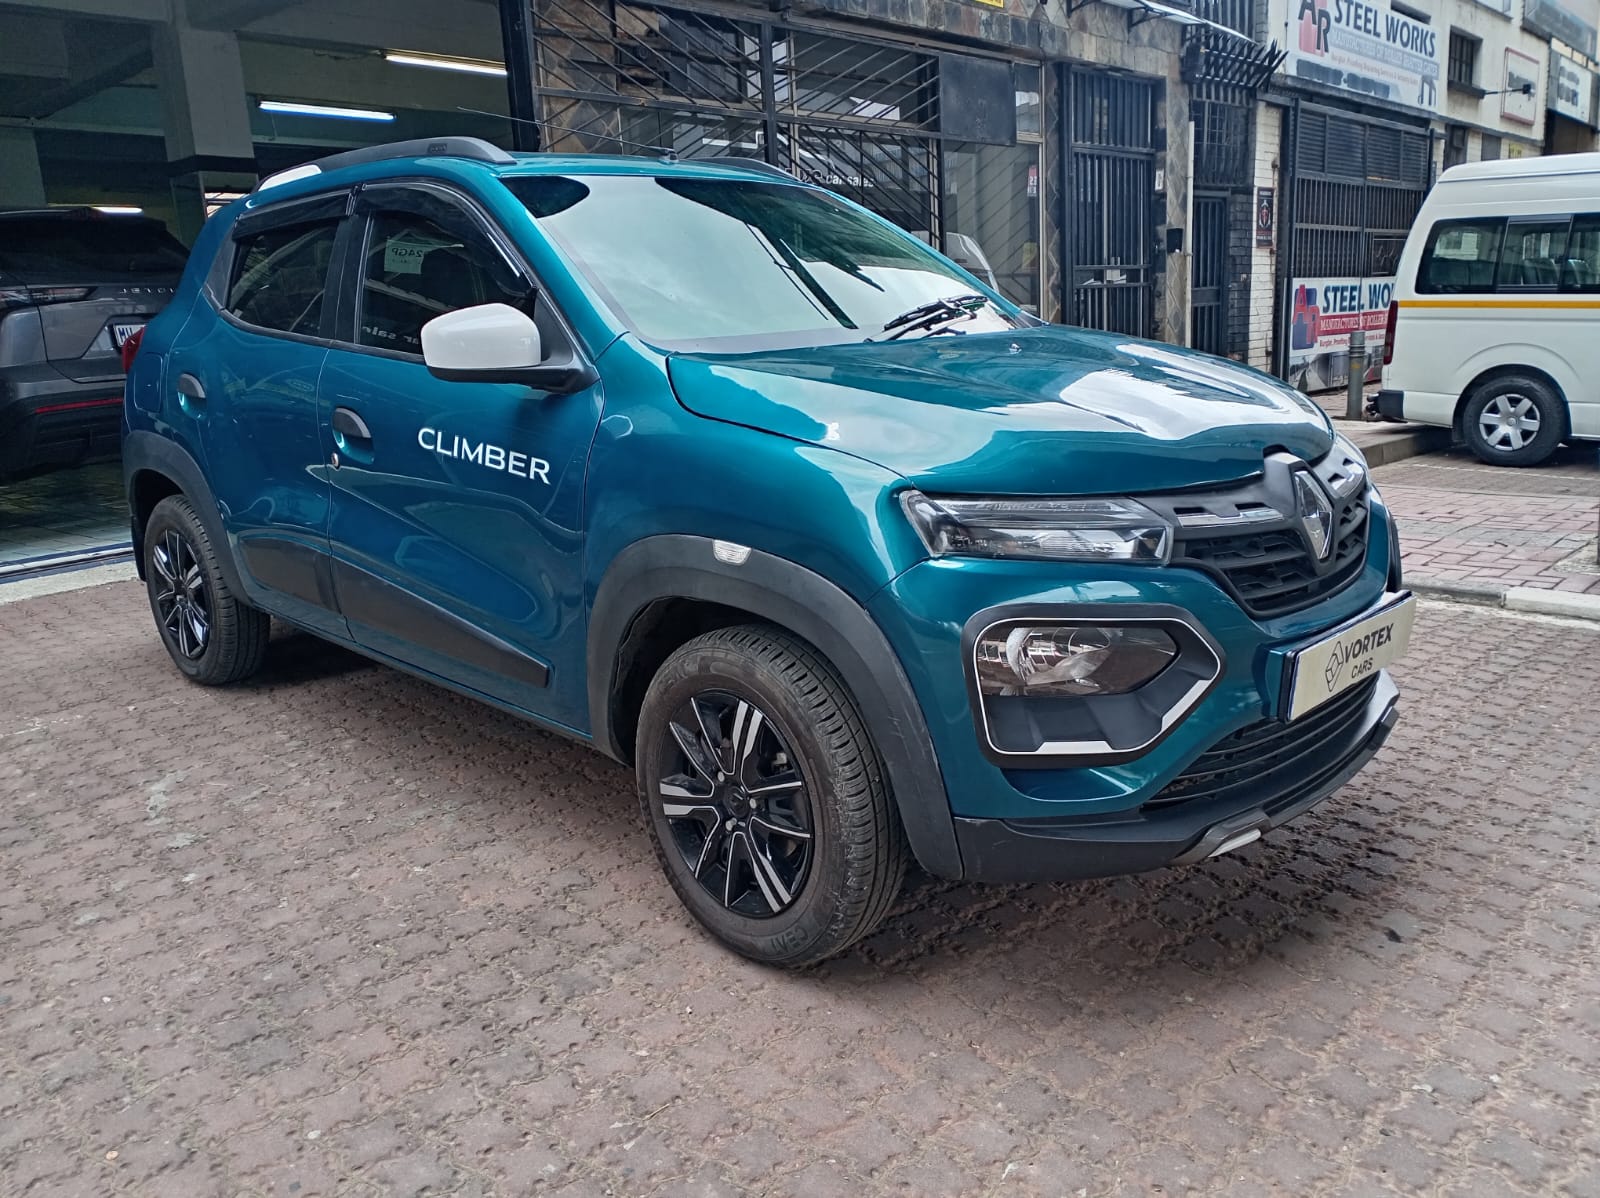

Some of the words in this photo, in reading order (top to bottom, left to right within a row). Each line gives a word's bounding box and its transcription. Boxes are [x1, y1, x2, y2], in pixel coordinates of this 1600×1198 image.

[1334, 0, 1381, 38] STEEL
[1385, 14, 1436, 58] WORKS
[1293, 284, 1319, 344] AR
[1322, 285, 1365, 313] STEEL
[418, 427, 551, 485] CLIMBER
[1345, 623, 1394, 663] VORTEX
[1351, 657, 1373, 679] CARS
